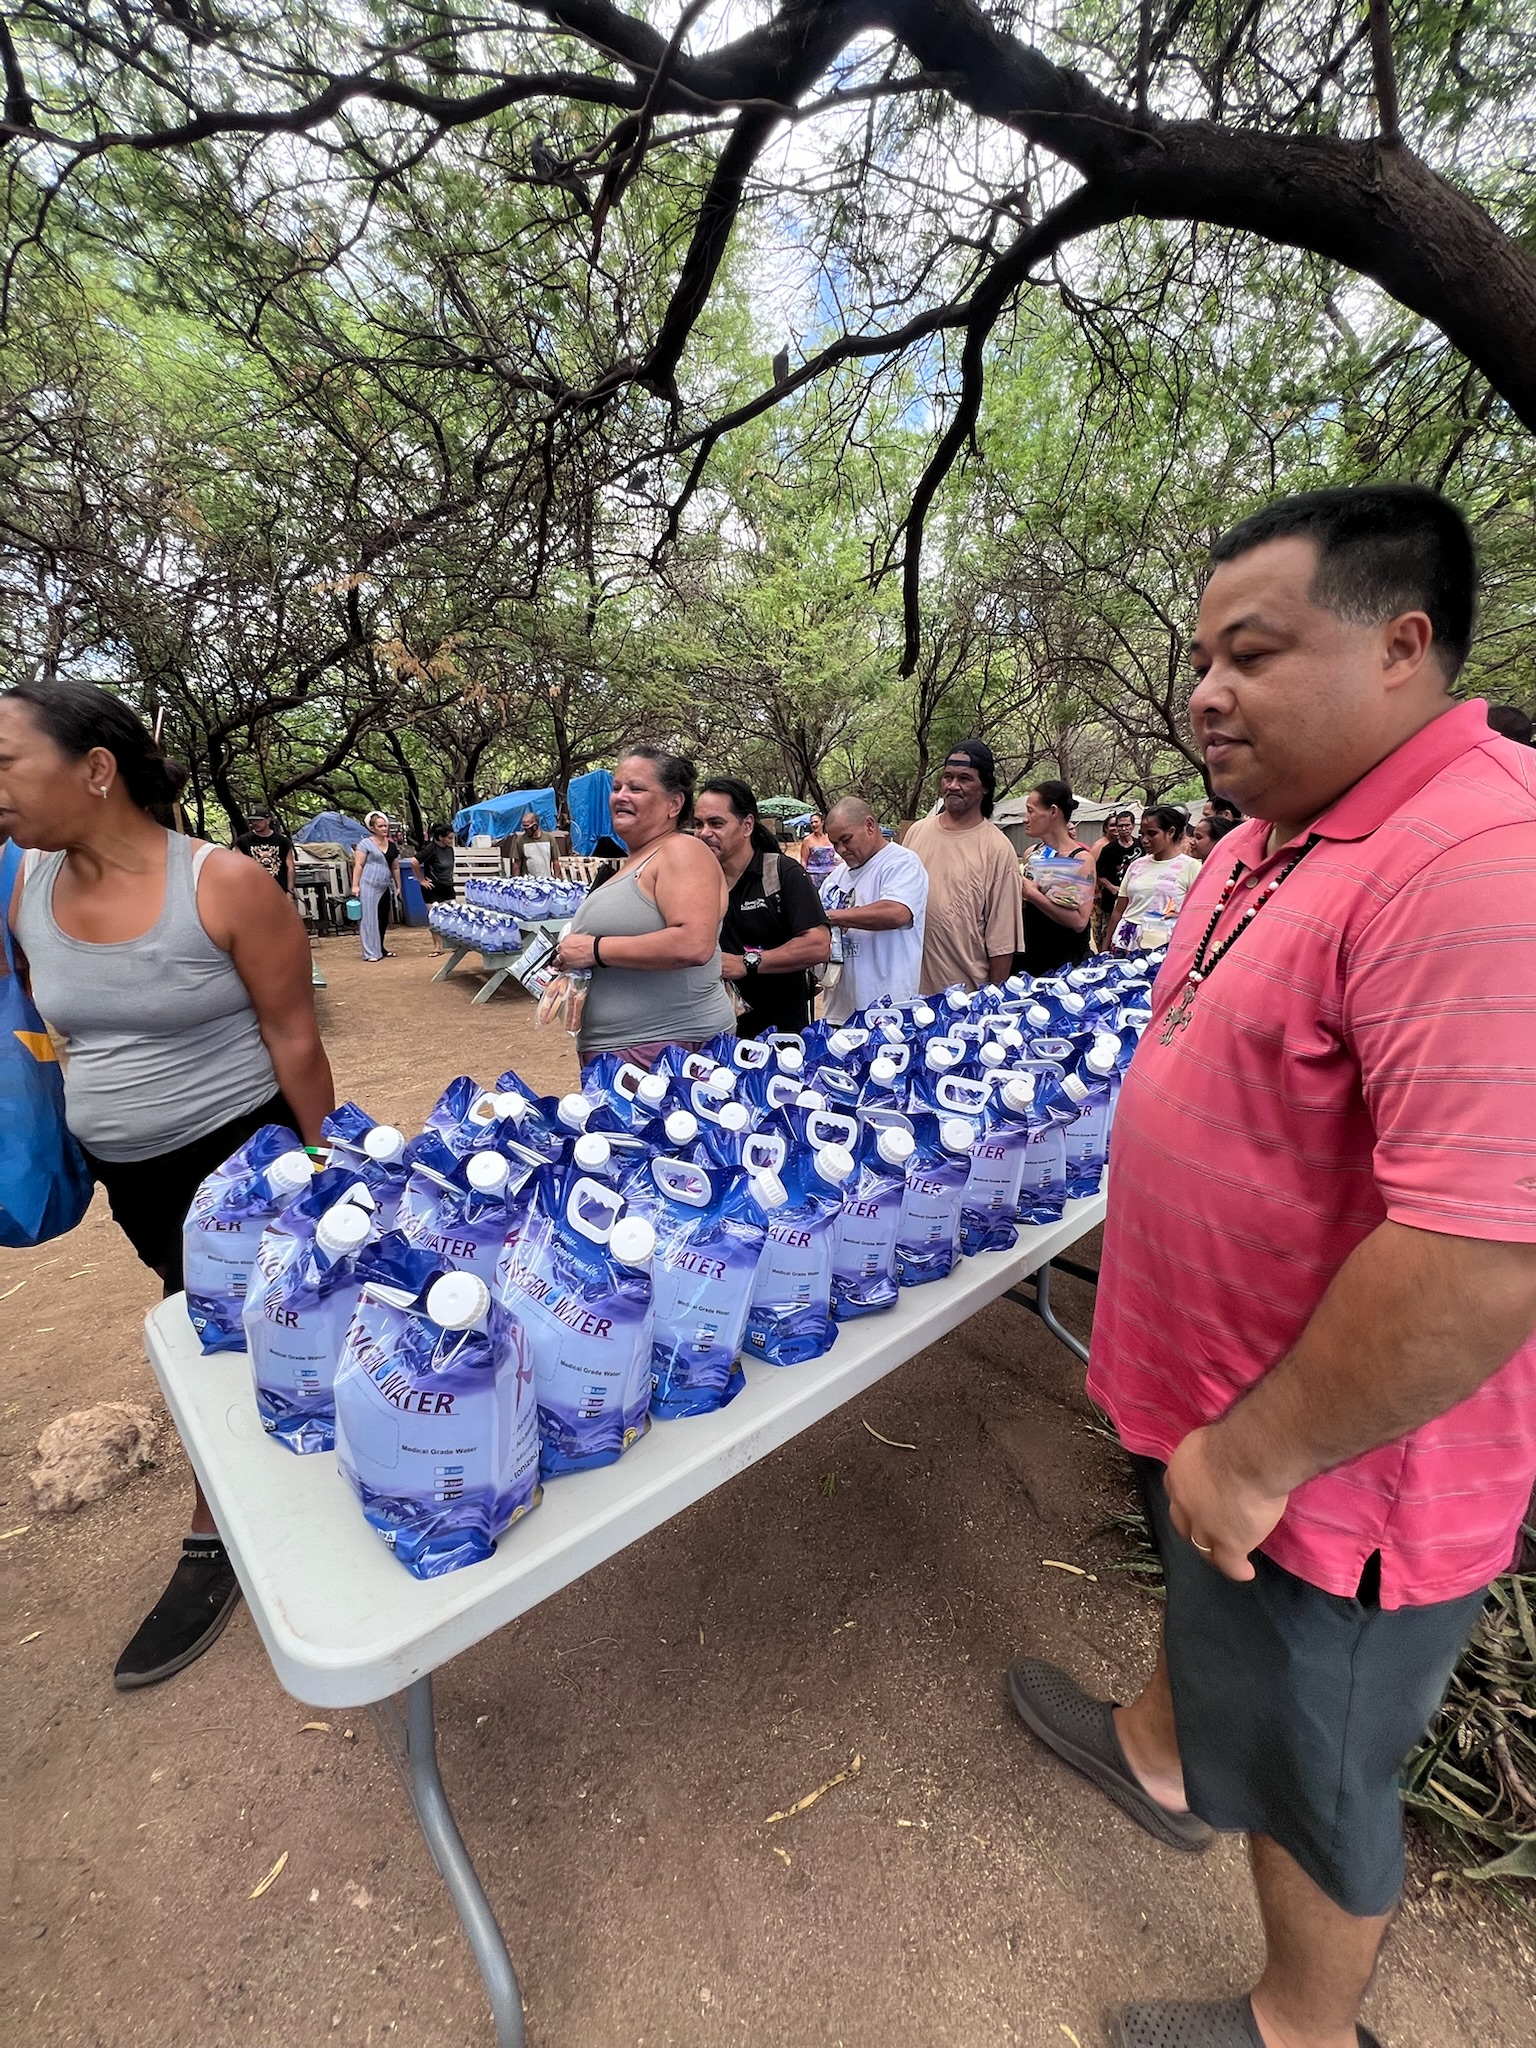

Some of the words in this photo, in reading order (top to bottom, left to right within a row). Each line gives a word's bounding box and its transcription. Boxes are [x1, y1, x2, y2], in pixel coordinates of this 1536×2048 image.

[968, 1145, 1006, 1160] ATER
[905, 1175, 943, 1195] ATER
[843, 1201, 879, 1218] TER
[768, 1226, 811, 1247] ATER
[667, 1250, 727, 1279] ATER
[553, 1297, 613, 1337] WATER
[560, 1359, 582, 1372] Medical
[583, 1367, 602, 1376] Grade
[381, 1370, 455, 1414] WATER
[401, 1444, 429, 1454] Medical
[455, 1446, 478, 1454] Water
